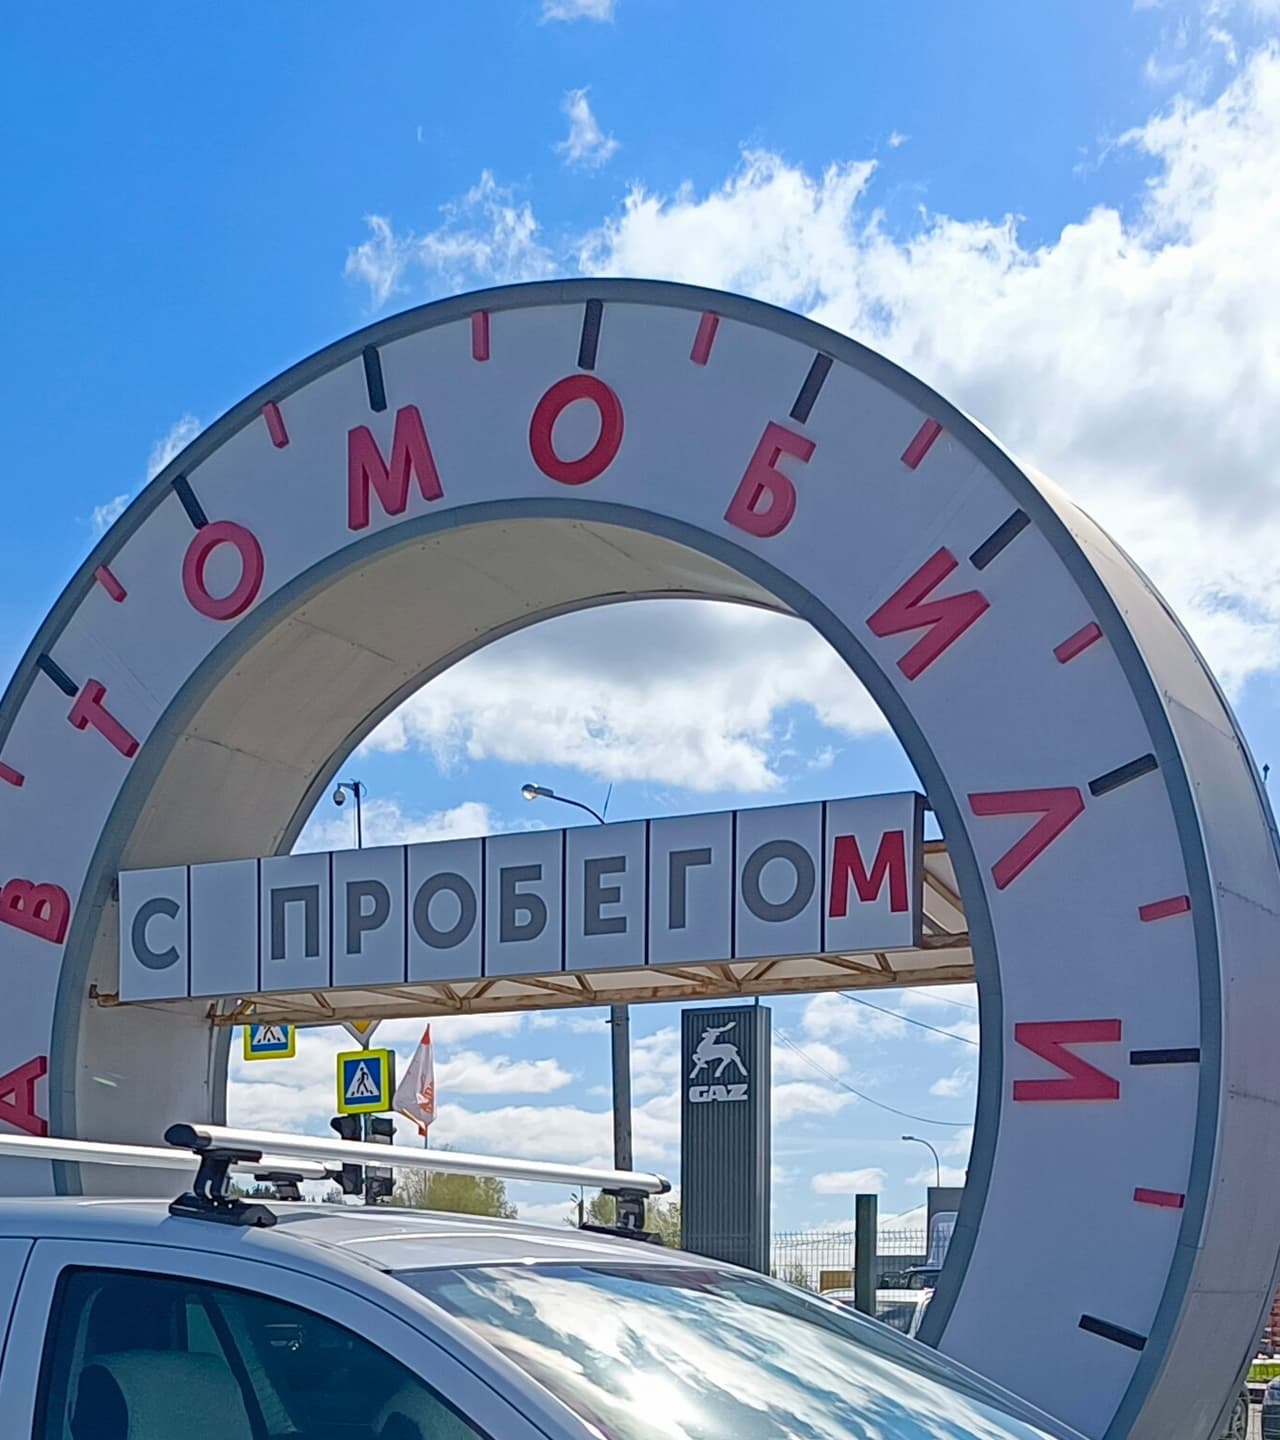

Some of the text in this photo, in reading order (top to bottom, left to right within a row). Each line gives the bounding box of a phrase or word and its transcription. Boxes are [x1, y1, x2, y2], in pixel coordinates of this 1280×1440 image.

[131, 830, 909, 970] С ПРОБЕГОМ
[689, 1084, 748, 1103] GAZ
